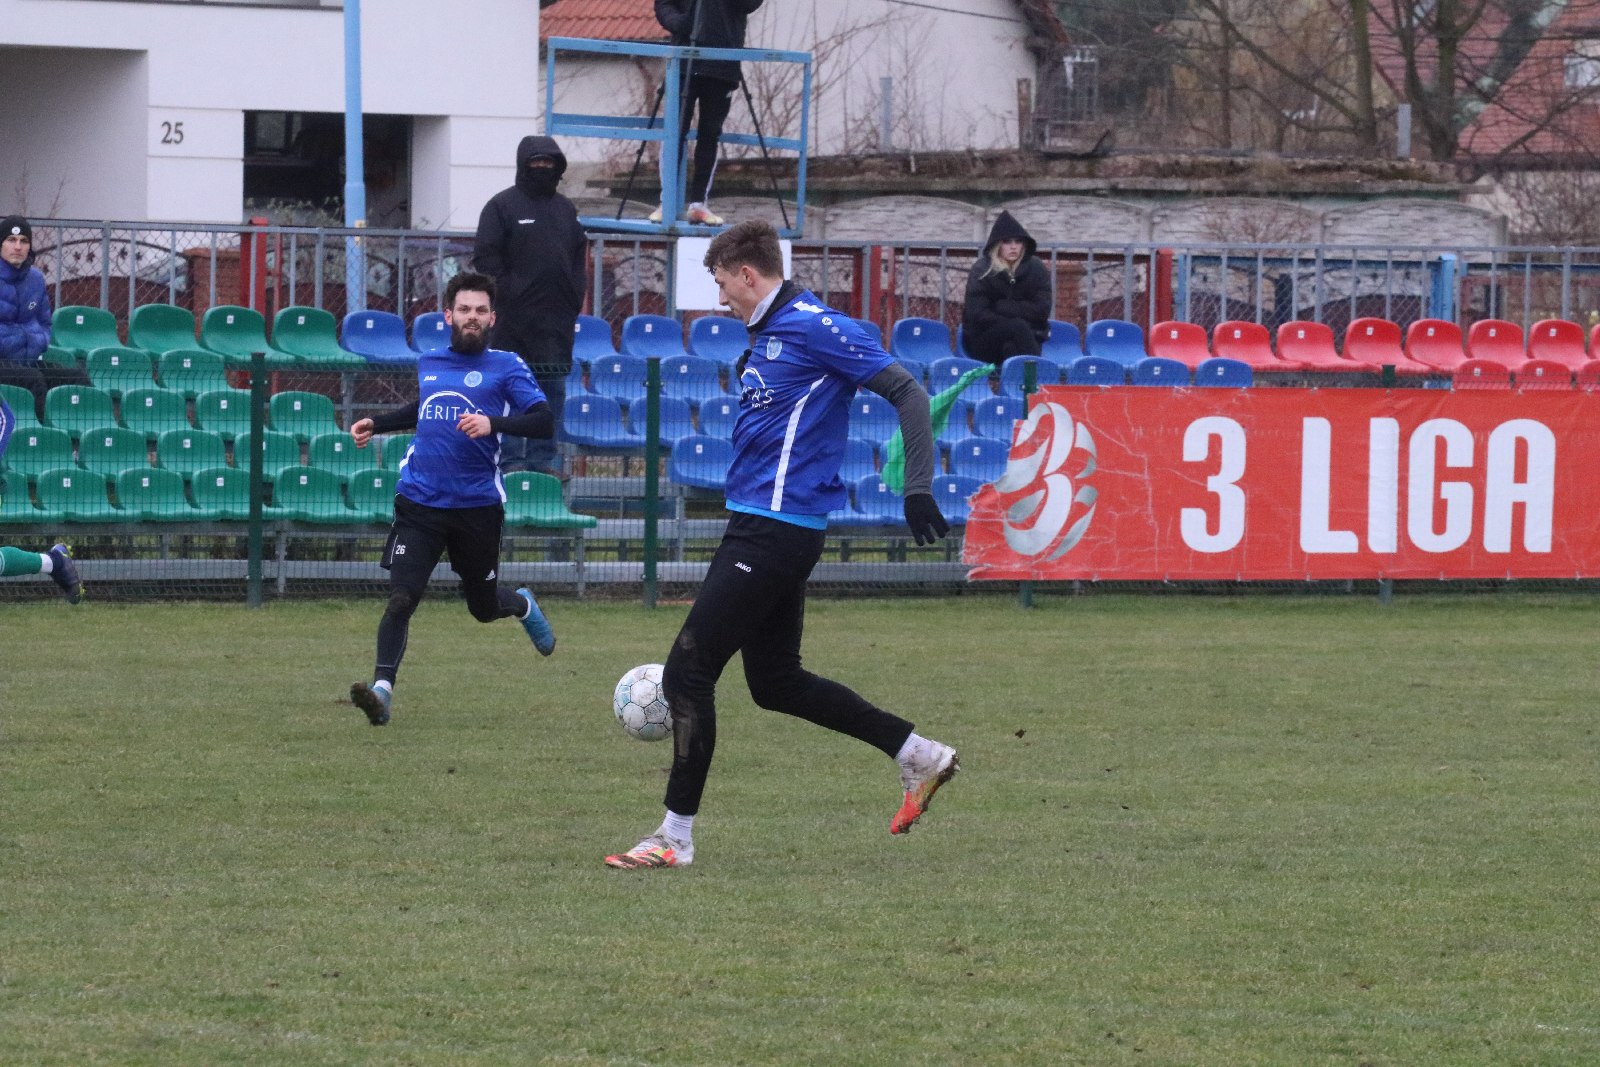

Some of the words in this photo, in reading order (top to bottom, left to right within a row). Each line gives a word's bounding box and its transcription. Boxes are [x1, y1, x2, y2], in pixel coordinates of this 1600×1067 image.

[161, 121, 184, 144] 25
[1180, 416, 1247, 553] 3
[1300, 416, 1556, 553] LIGA
[395, 544, 406, 555] 26
[734, 561, 752, 573] JAKO
